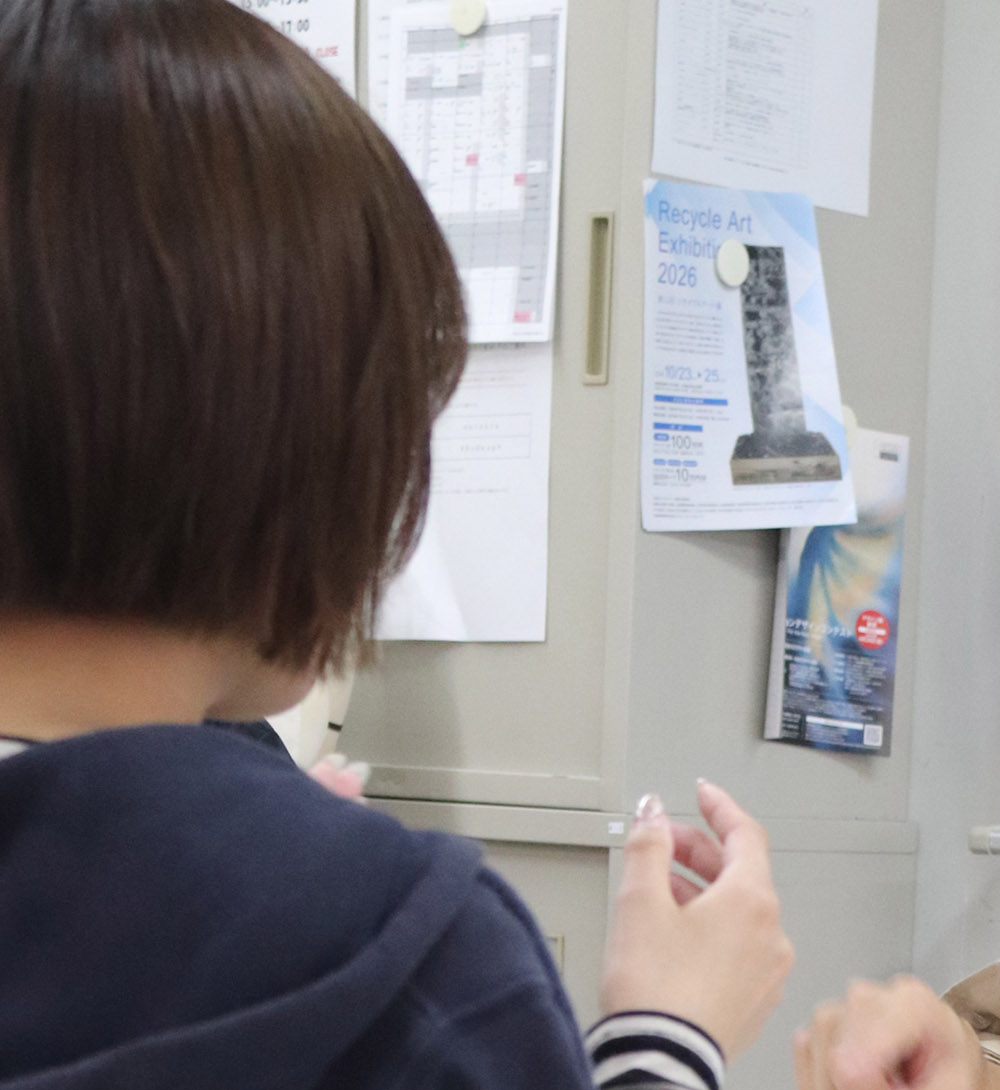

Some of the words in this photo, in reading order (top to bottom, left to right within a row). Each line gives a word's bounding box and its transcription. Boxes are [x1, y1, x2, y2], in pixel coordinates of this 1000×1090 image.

[658, 201, 722, 231] Recycle
[727, 211, 752, 234] Art
[658, 232, 720, 260] Exhibiti
[657, 263, 698, 288] 2026
